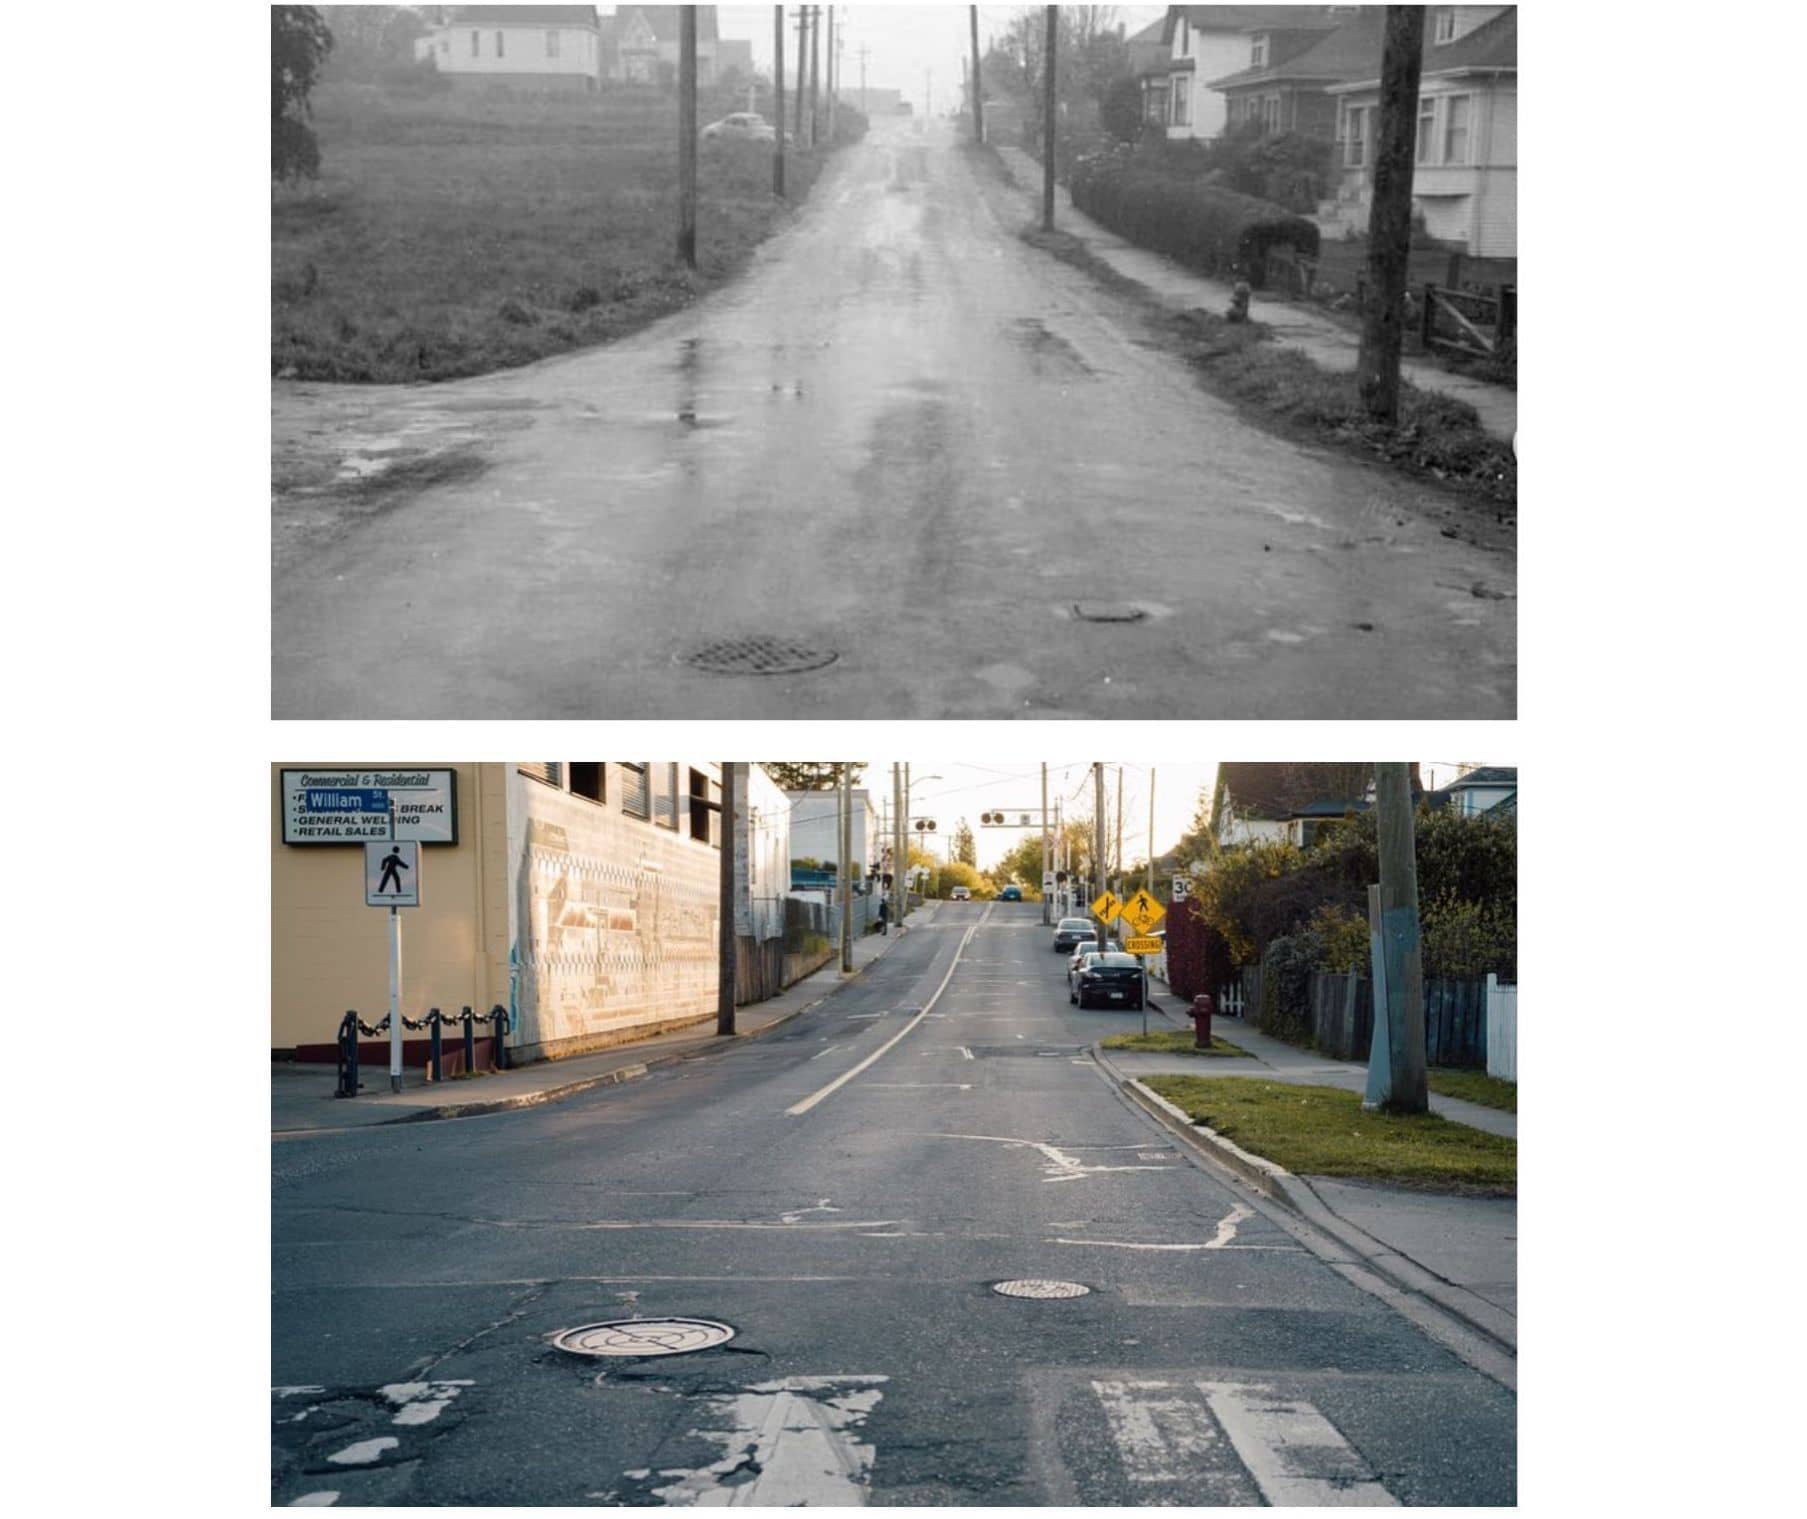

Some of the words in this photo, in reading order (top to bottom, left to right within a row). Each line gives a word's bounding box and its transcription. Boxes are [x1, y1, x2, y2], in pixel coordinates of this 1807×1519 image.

[301, 774, 359, 787] Commercial
[361, 775, 371, 785] &
[374, 773, 430, 786] Residential
[310, 792, 362, 808] William
[400, 804, 444, 813] BREAK
[298, 816, 358, 825] GENERAL
[361, 816, 420, 825] WELING
[299, 827, 342, 836] RETAIL
[345, 827, 386, 836] SALES
[1127, 939, 1160, 950] CROSSING
